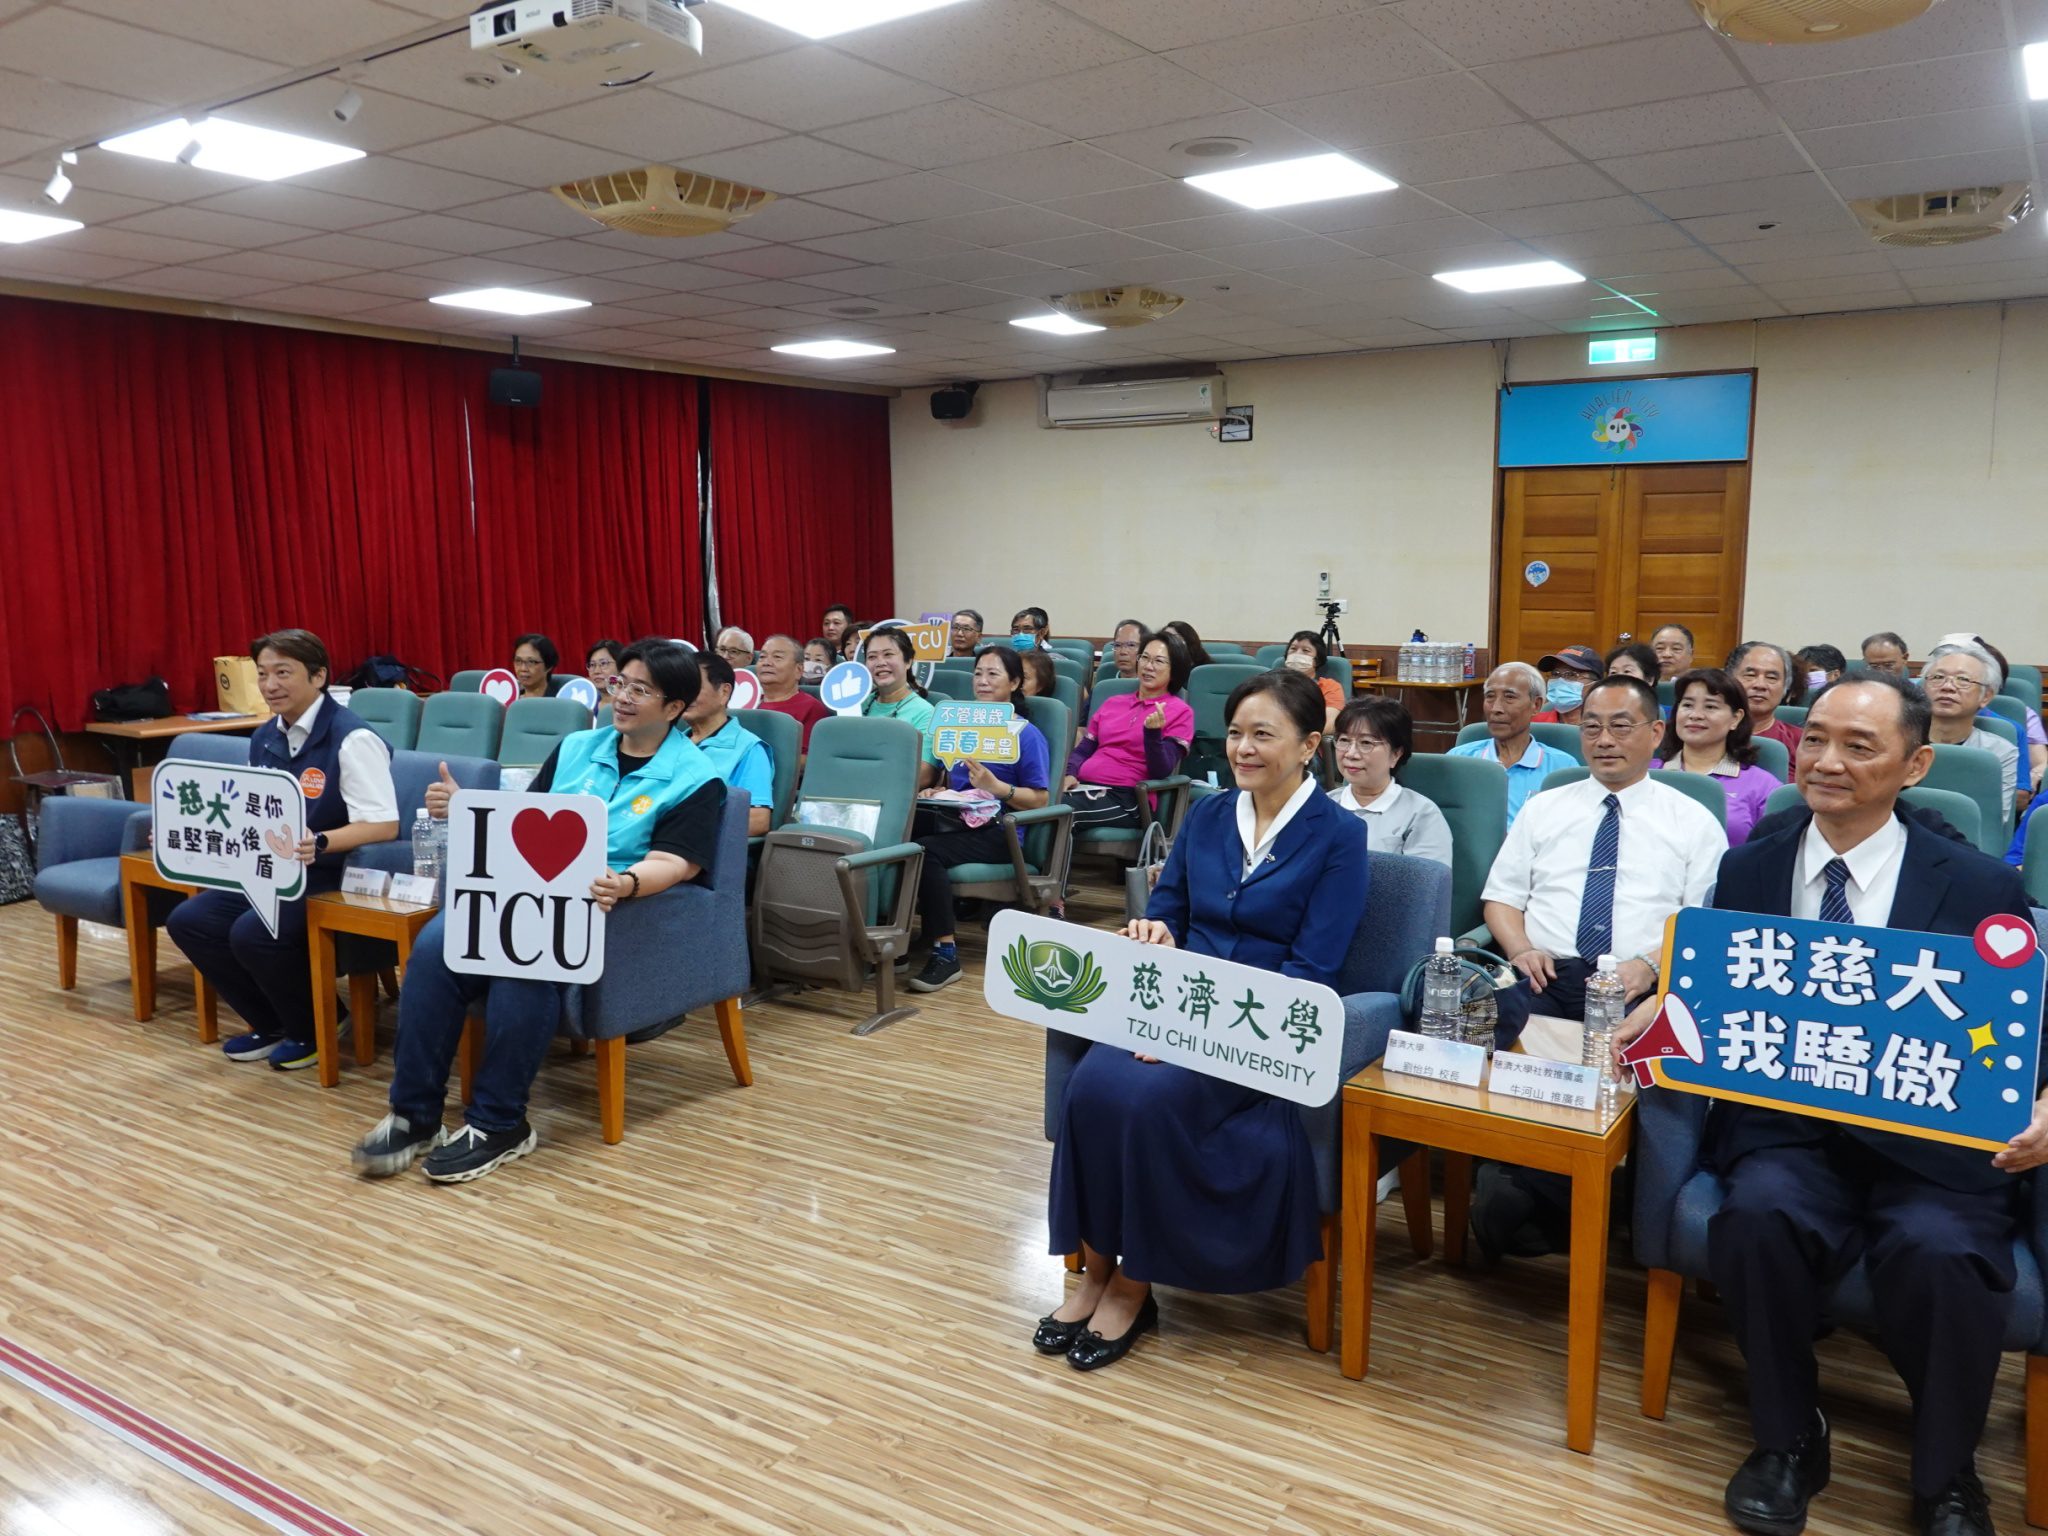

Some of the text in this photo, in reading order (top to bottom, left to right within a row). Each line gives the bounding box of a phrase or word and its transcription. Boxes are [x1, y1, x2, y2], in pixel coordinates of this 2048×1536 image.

[465, 806, 496, 879] I
[453, 888, 598, 971] TCU
[1129, 962, 1322, 1054] 慈濟大學
[1726, 927, 1965, 1021] 我慈大
[1127, 1017, 1316, 1086] TZU CHI UNIVERSITY
[1510, 1084, 1544, 1099] 牛河山
[1717, 1009, 1962, 1112] 我驕傲
